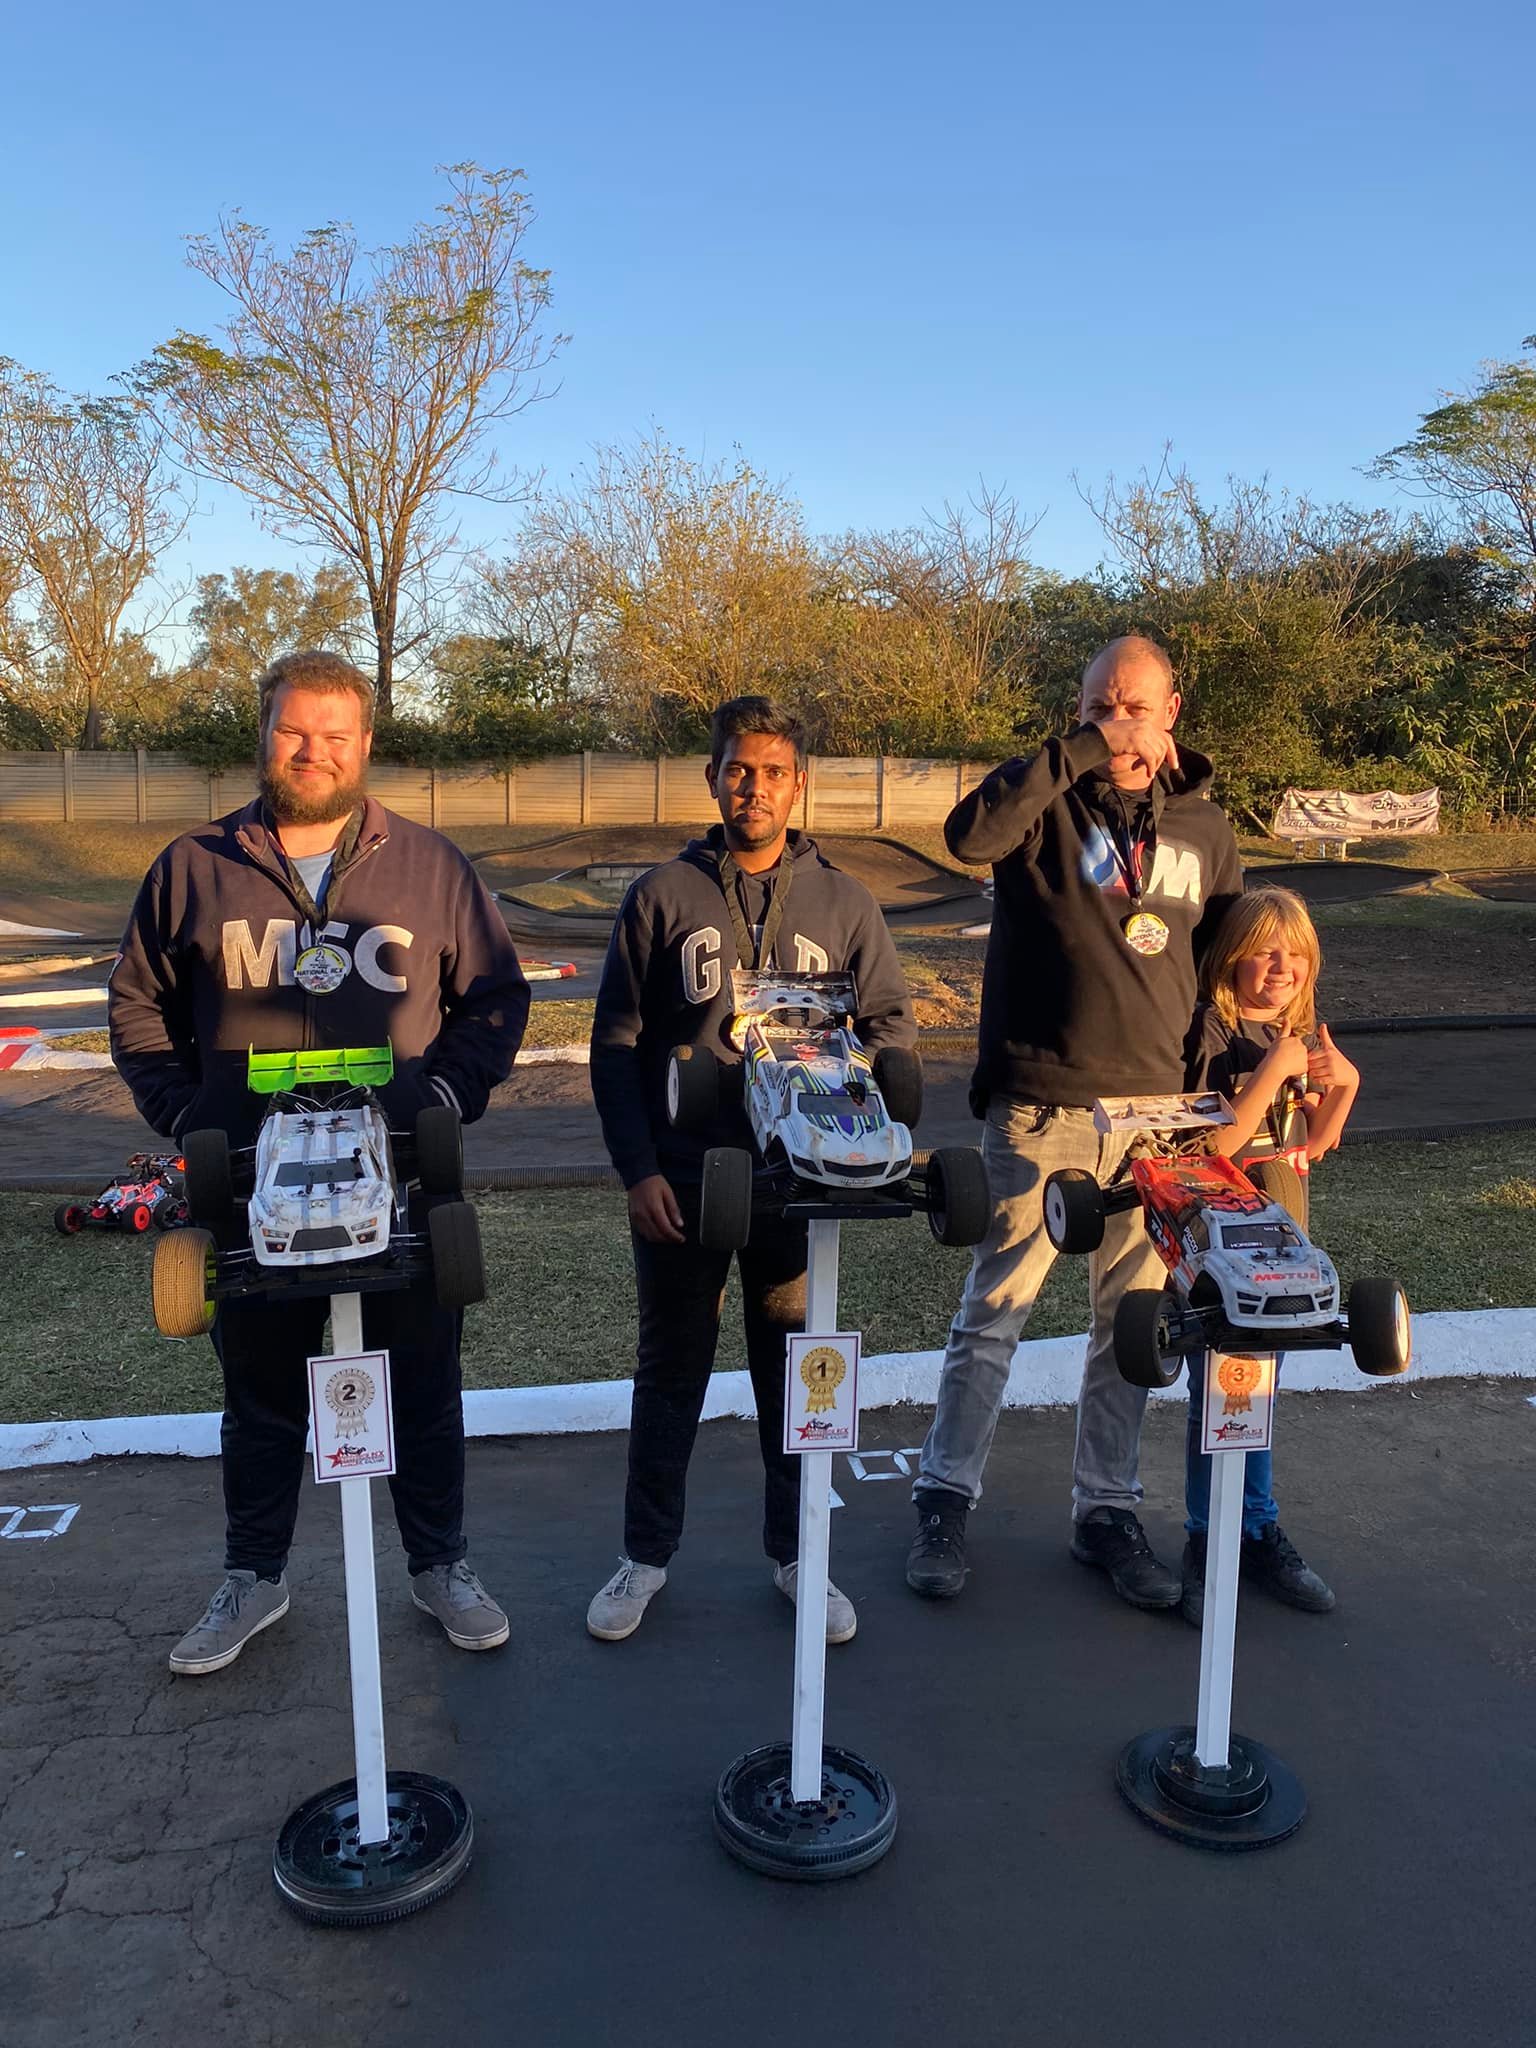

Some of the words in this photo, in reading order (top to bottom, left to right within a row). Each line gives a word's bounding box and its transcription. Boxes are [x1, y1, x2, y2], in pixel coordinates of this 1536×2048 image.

[297, 968, 329, 976] NATIONAL
[1183, 1225, 1199, 1254] PICCO
[1253, 1269, 1320, 1282] MOTUL
[816, 1361, 827, 1378] 1
[1233, 1367, 1245, 1382] 3
[342, 1384, 357, 1401] 2
